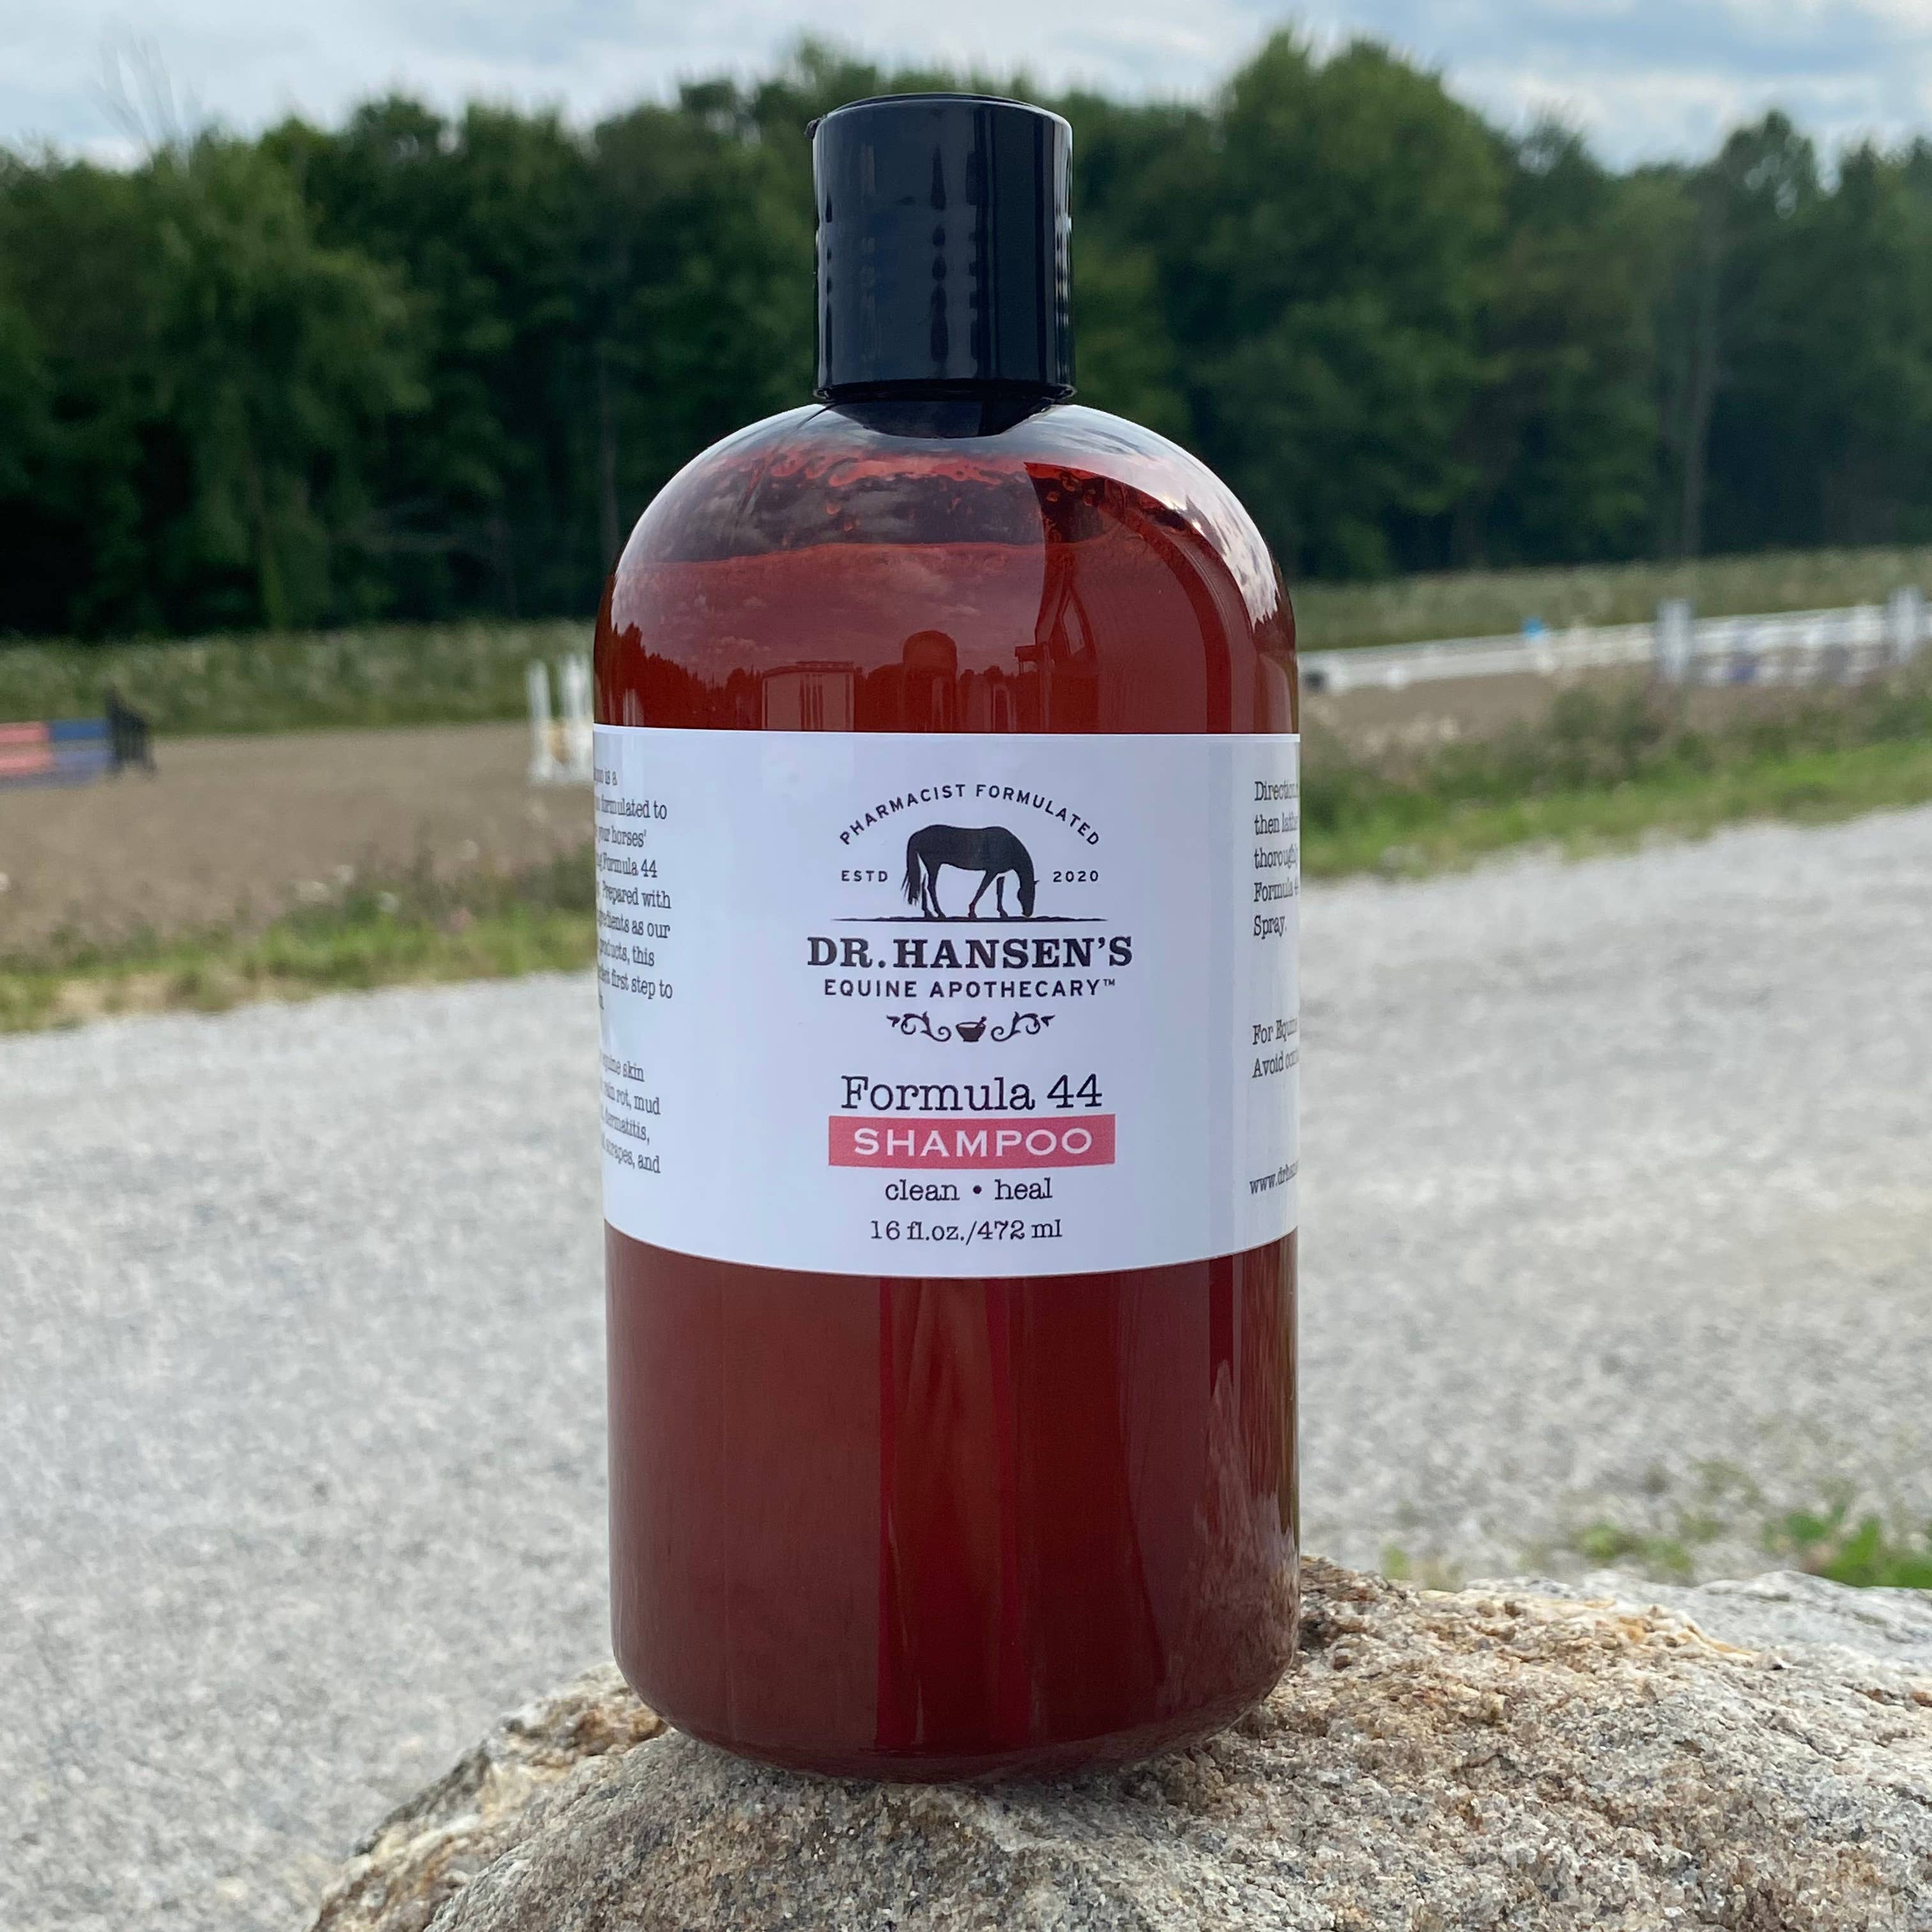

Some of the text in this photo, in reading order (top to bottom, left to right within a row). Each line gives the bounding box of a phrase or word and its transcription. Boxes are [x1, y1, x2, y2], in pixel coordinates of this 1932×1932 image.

[654, 801, 667, 820] to
[839, 784, 1100, 846] PHARMACIST FORMULATED
[1254, 813, 1280, 836] then
[641, 859, 658, 878] 44
[841, 870, 1100, 883] ESTD 2020
[641, 889, 671, 908] with
[1254, 877, 1293, 903] Formula
[632, 920, 644, 936] as
[647, 923, 671, 939] our
[1253, 914, 1287, 940] Spray.
[632, 946, 655, 967] this
[611, 968, 629, 991] first
[631, 976, 656, 1000] step
[659, 979, 673, 999] to
[824, 979, 917, 998] EQUINE
[1252, 1023, 1274, 1045] For
[623, 1061, 645, 1082] skin
[1252, 1050, 1284, 1078] Avoid
[617, 1089, 631, 1110] rot,
[634, 1096, 661, 1116] mud
[840, 1073, 1103, 1112] Formula 44
[854, 1127, 1093, 1157] SHAMPOO
[638, 1154, 661, 1174] and
[884, 1177, 1053, 1201] clean heal
[870, 1220, 901, 1240] 16
[1031, 1218, 1063, 1239] ml
